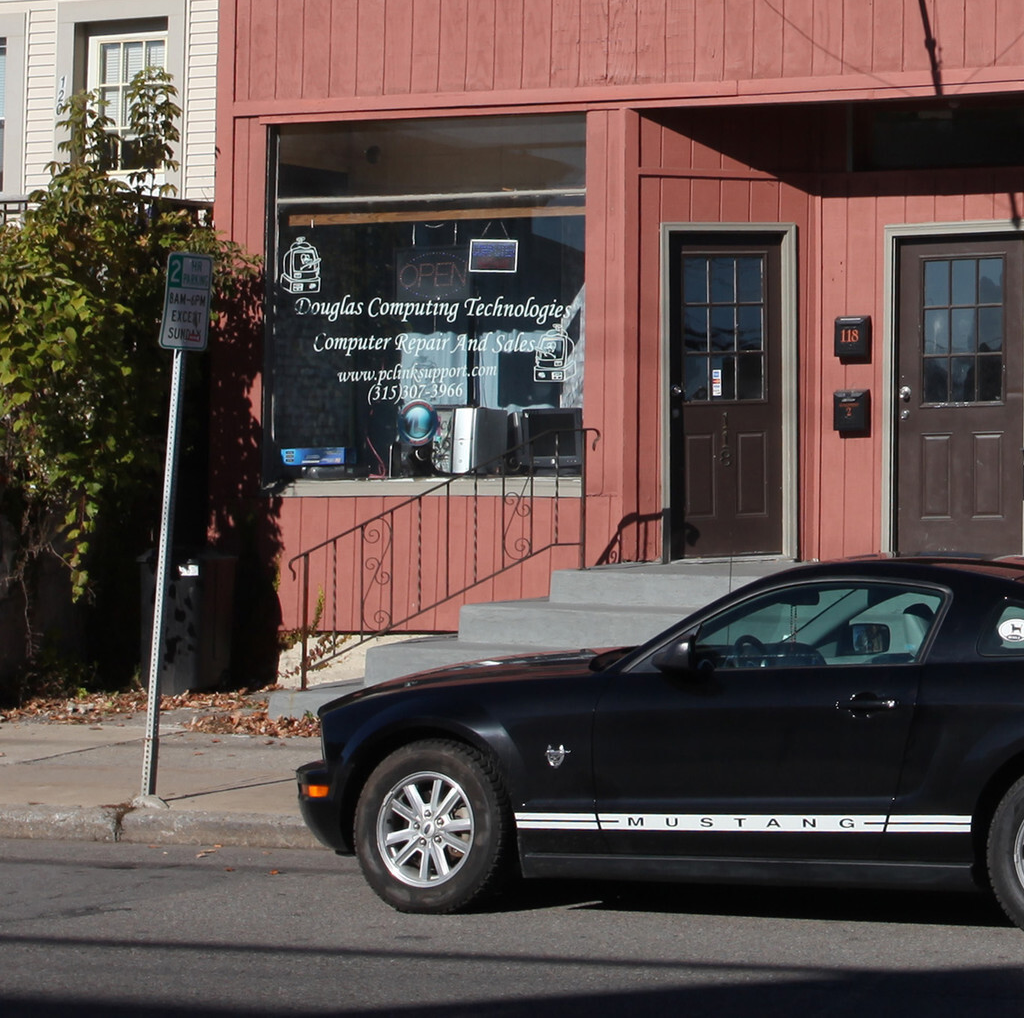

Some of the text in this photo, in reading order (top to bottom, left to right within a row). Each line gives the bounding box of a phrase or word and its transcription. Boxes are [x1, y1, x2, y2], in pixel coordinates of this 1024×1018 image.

[170, 260, 181, 283] 2
[191, 260, 203, 273] HR
[399, 262, 468, 288] OPEN
[294, 295, 572, 325] Douglas Computing Technologies
[313, 332, 535, 357] Computer Repair And Sales
[841, 329, 859, 343] 118
[337, 363, 498, 386] www.pclinksupport.com
[367, 383, 464, 405] (315)307-3966
[846, 407, 853, 416] 2
[627, 816, 856, 829] MUSTANG
